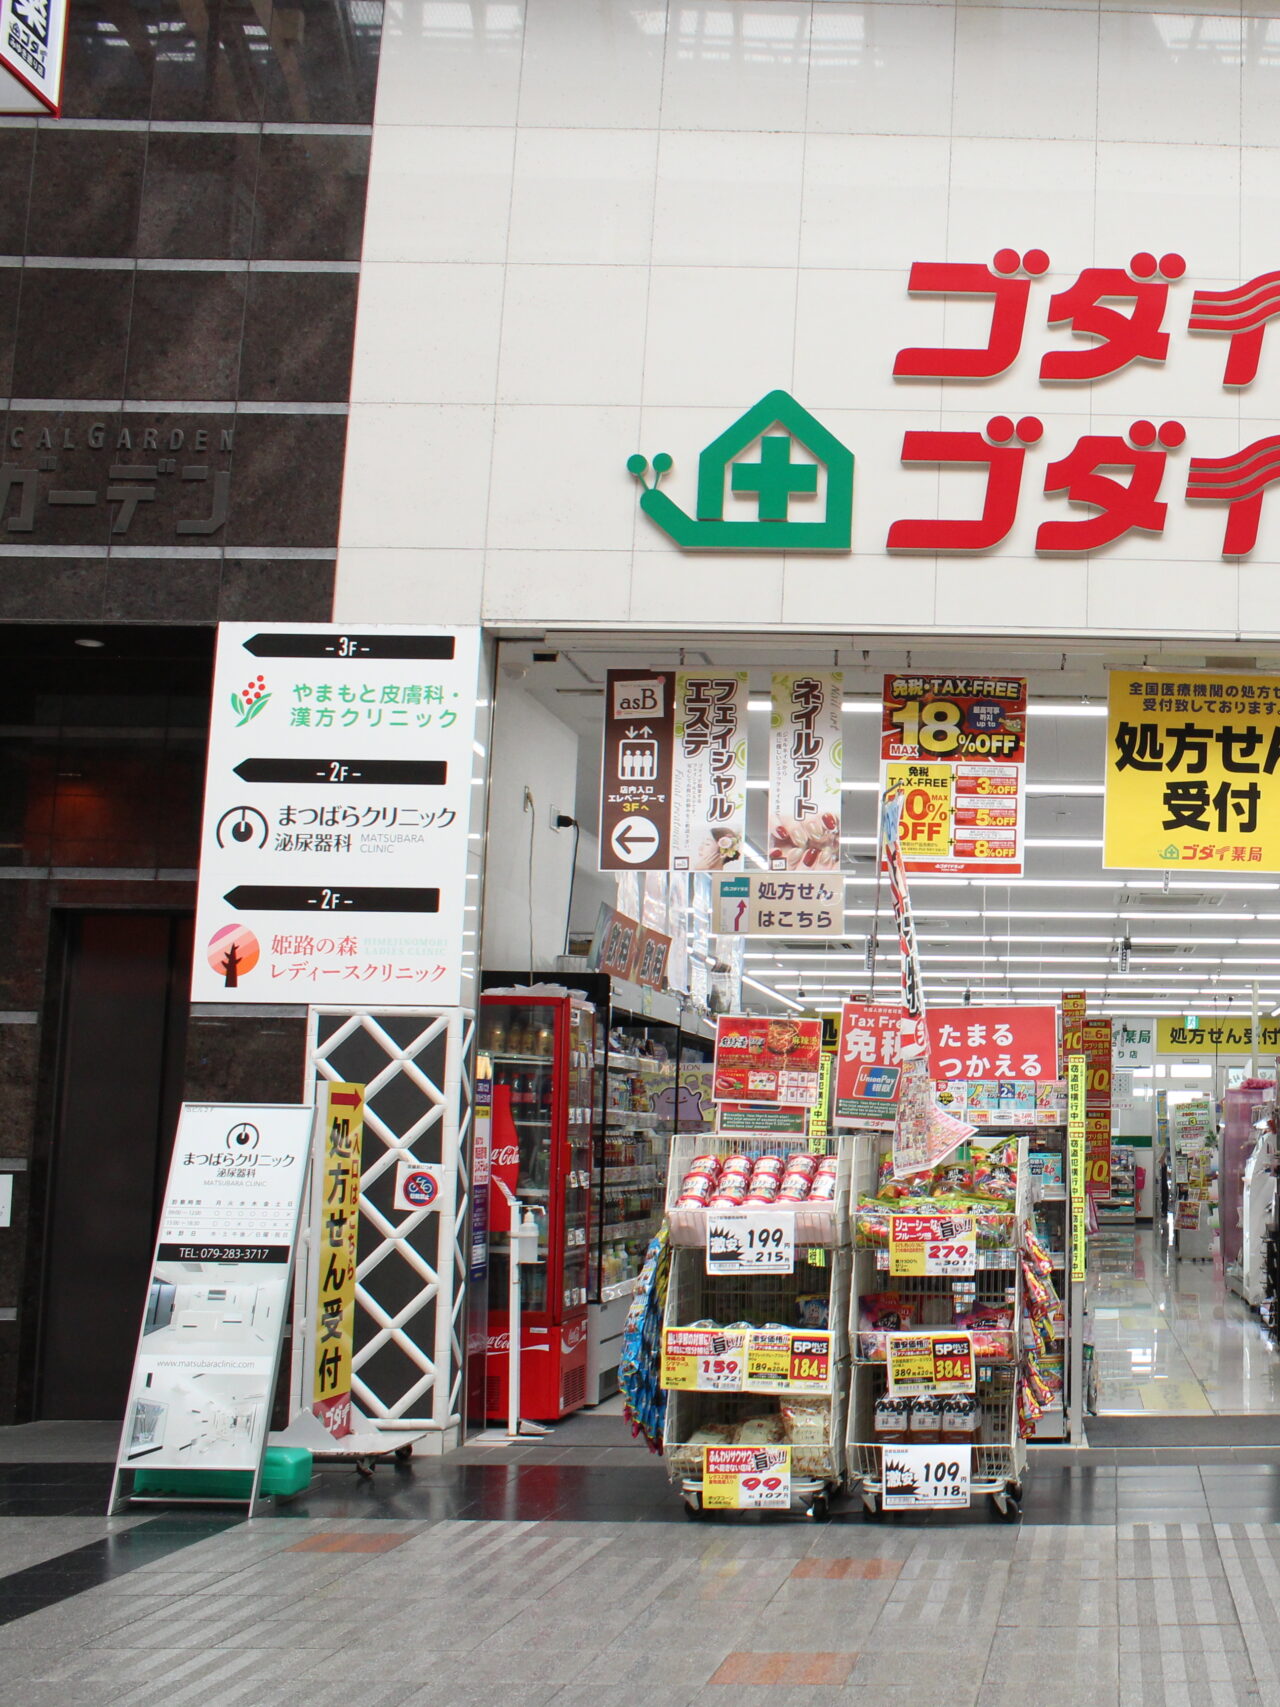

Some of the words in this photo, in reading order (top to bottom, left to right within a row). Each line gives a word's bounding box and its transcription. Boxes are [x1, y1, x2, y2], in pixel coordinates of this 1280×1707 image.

[290, 707, 458, 728] 漢方クリニック
[683, 679, 712, 758] エステ
[707, 679, 737, 822] フェイシャル
[791, 678, 823, 821] ネイルアート
[890, 744, 918, 756] MAX
[608, 794, 665, 803] エレベーターで
[1162, 780, 1261, 833] 受付
[278, 805, 456, 828] まつばらクリニック
[274, 833, 352, 853] 泌尿器科
[361, 833, 424, 844] MATSUBARA
[360, 845, 394, 854] CLINIC
[1181, 845, 1262, 862] ゴダイ薬局
[759, 882, 833, 901] 処方せん
[758, 911, 833, 928] はこちら
[271, 934, 357, 956] 姫路の森
[271, 963, 447, 983] レディースクリニック
[849, 1014, 875, 1027] Tax
[878, 1016, 902, 1029] Fre
[938, 1025, 1013, 1047] たまる
[939, 1054, 1042, 1077] つかえる
[860, 1074, 895, 1086] UnionPay
[183, 1152, 295, 1167] まつばらクリニック
[217, 1168, 256, 1178] 泌尿器科
[347, 1134, 359, 1280] 入口はこちら
[180, 1248, 198, 1257] TEL:
[201, 1248, 268, 1259] 079-283-3717
[318, 1116, 350, 1393] 処方せん受付
[157, 1360, 255, 1369] www.matsubaraclinic.com
